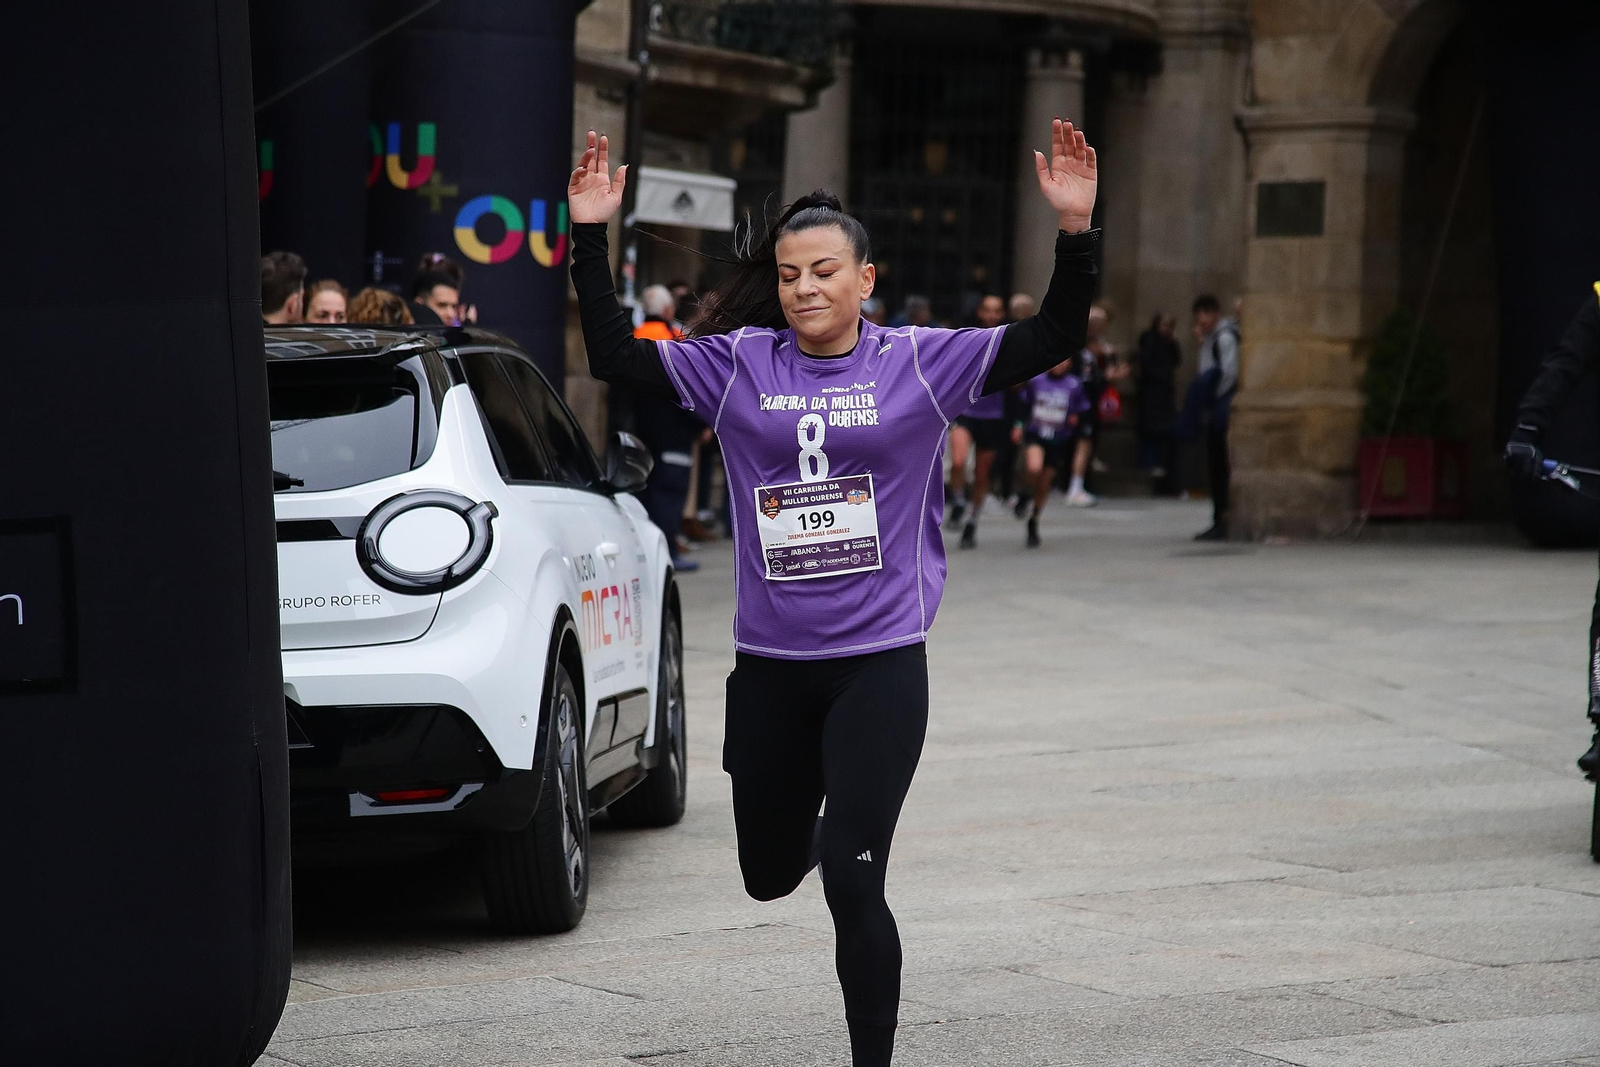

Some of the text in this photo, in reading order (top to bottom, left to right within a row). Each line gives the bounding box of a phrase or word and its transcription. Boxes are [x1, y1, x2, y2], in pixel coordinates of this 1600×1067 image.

[759, 393, 876, 411] CARREIRA DA MULLER
[828, 409, 880, 428] OURENSE
[797, 413, 829, 482] 8
[782, 488, 793, 496] VII
[793, 484, 828, 495] CARREIRA
[782, 492, 843, 506] MULLER OURENSE
[797, 510, 835, 530] 199
[279, 594, 381, 609] RUPO ROFER
[581, 583, 633, 654] MICRA
